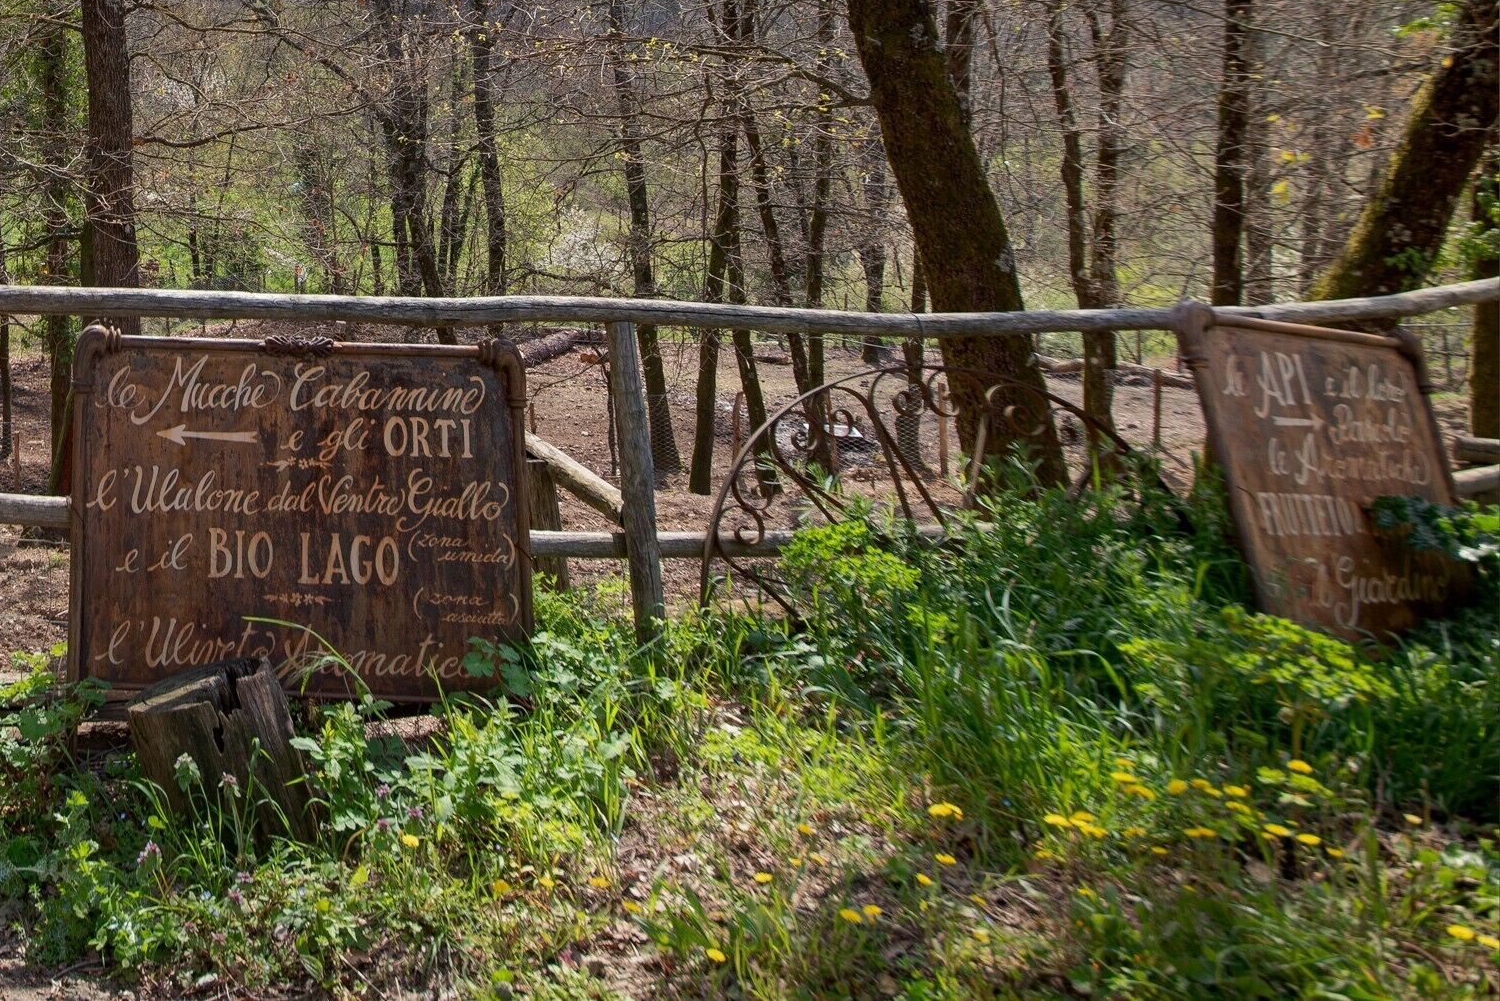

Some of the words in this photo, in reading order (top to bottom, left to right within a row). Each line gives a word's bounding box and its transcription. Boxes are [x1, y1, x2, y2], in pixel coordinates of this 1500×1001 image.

[95, 366, 146, 409] le
[131, 354, 281, 425] Mucche
[1254, 351, 1312, 418] API
[280, 430, 304, 451] e
[317, 417, 376, 461] gli
[384, 416, 474, 459] ORTI
[263, 480, 316, 514] dal
[318, 475, 405, 515] Ventre
[396, 468, 510, 532] Giallo
[116, 548, 139, 573] e
[147, 533, 193, 571] il
[208, 527, 274, 579] BIO
[298, 532, 400, 586] LAGO
[276, 623, 484, 680] Aromatic
